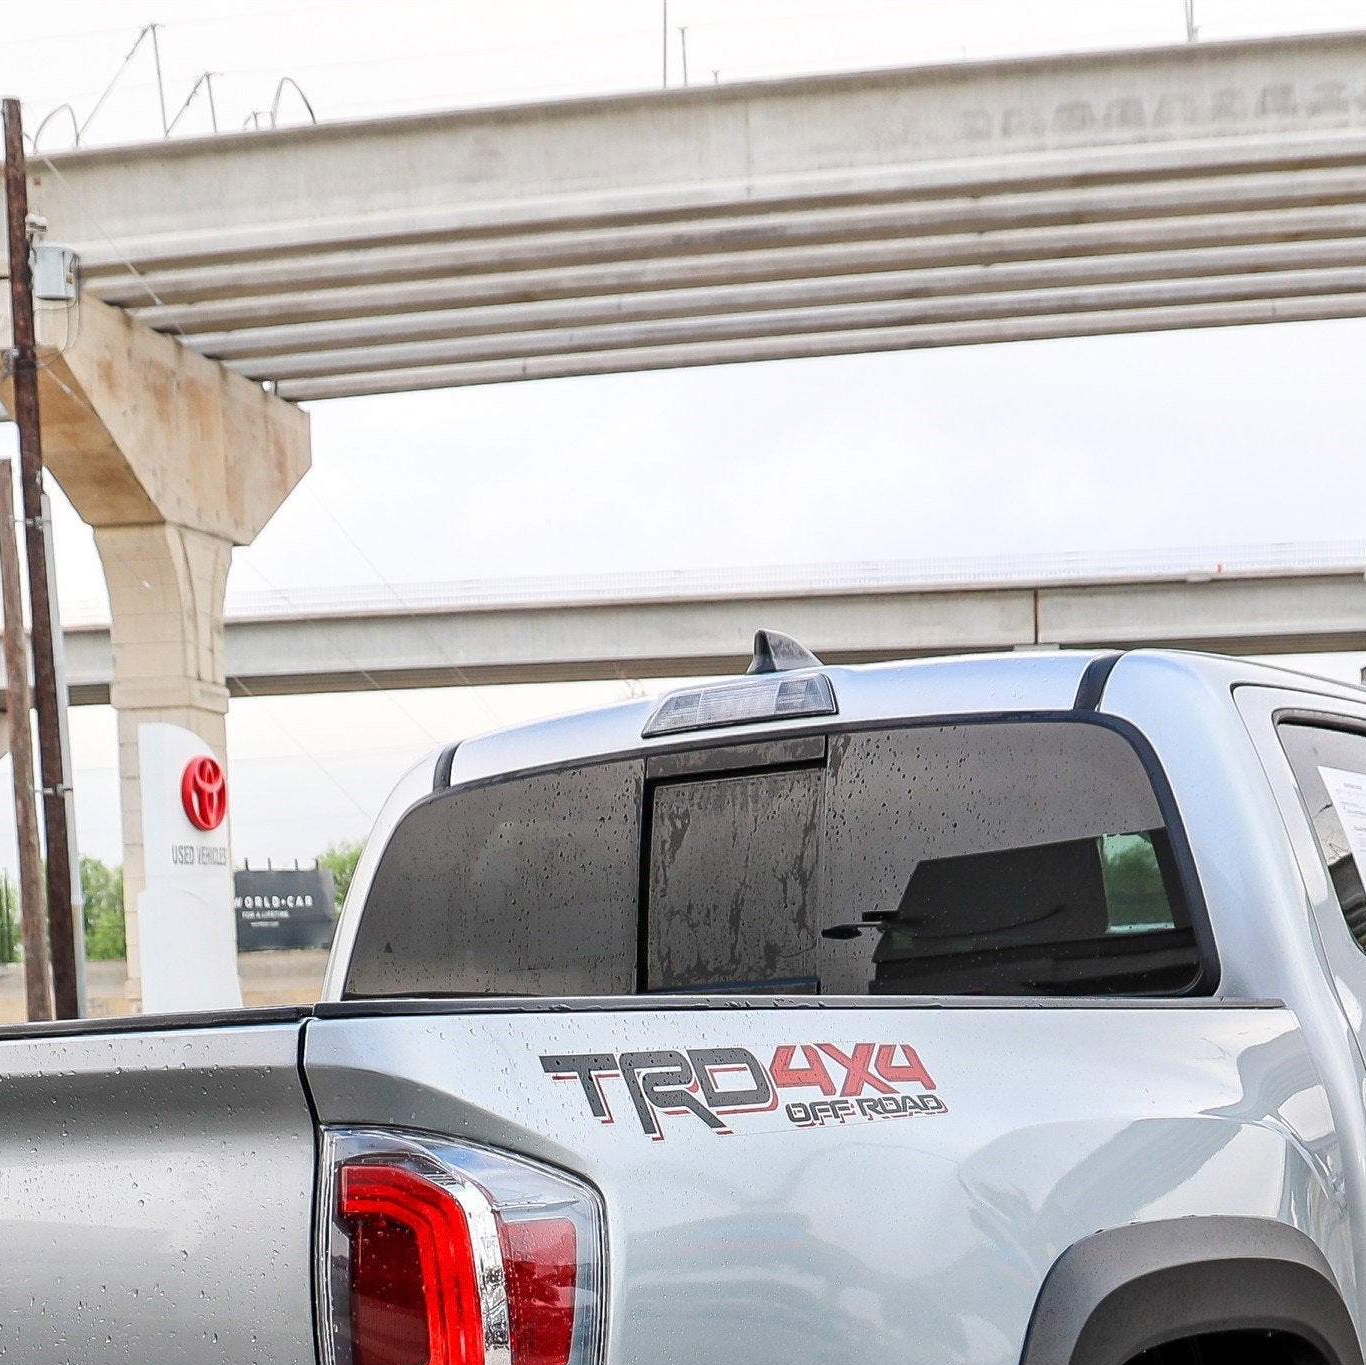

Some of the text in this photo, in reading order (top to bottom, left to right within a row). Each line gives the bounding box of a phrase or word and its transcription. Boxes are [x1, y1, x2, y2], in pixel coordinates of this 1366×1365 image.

[171, 845, 227, 866] USED VEHICLES
[538, 1046, 780, 1141] TRD
[785, 1093, 949, 1128] OFF ROAD
